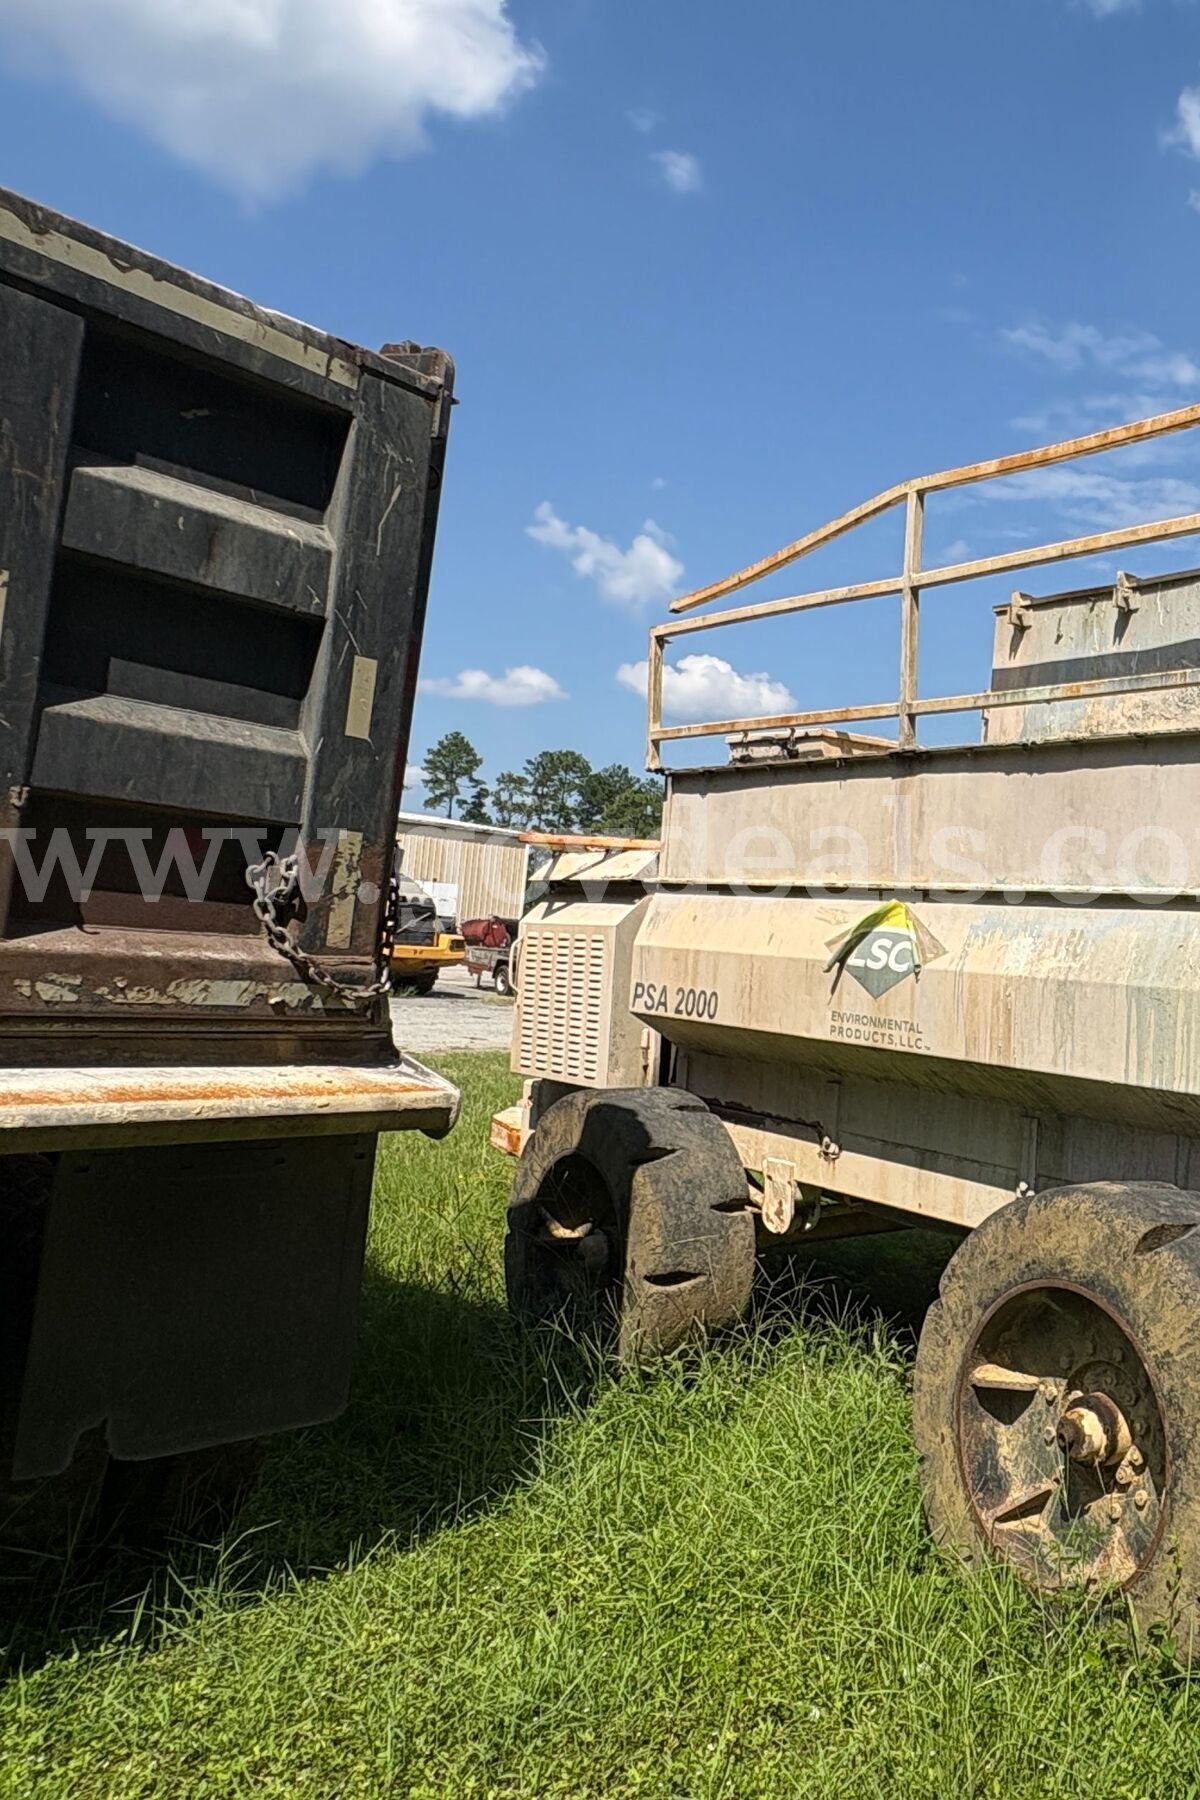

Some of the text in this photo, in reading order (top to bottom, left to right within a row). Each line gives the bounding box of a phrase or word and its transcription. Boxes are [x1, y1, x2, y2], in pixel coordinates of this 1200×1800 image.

[632, 982, 719, 1020] PSA 2000
[831, 1010, 923, 1034] ENVIRONMENTAL
